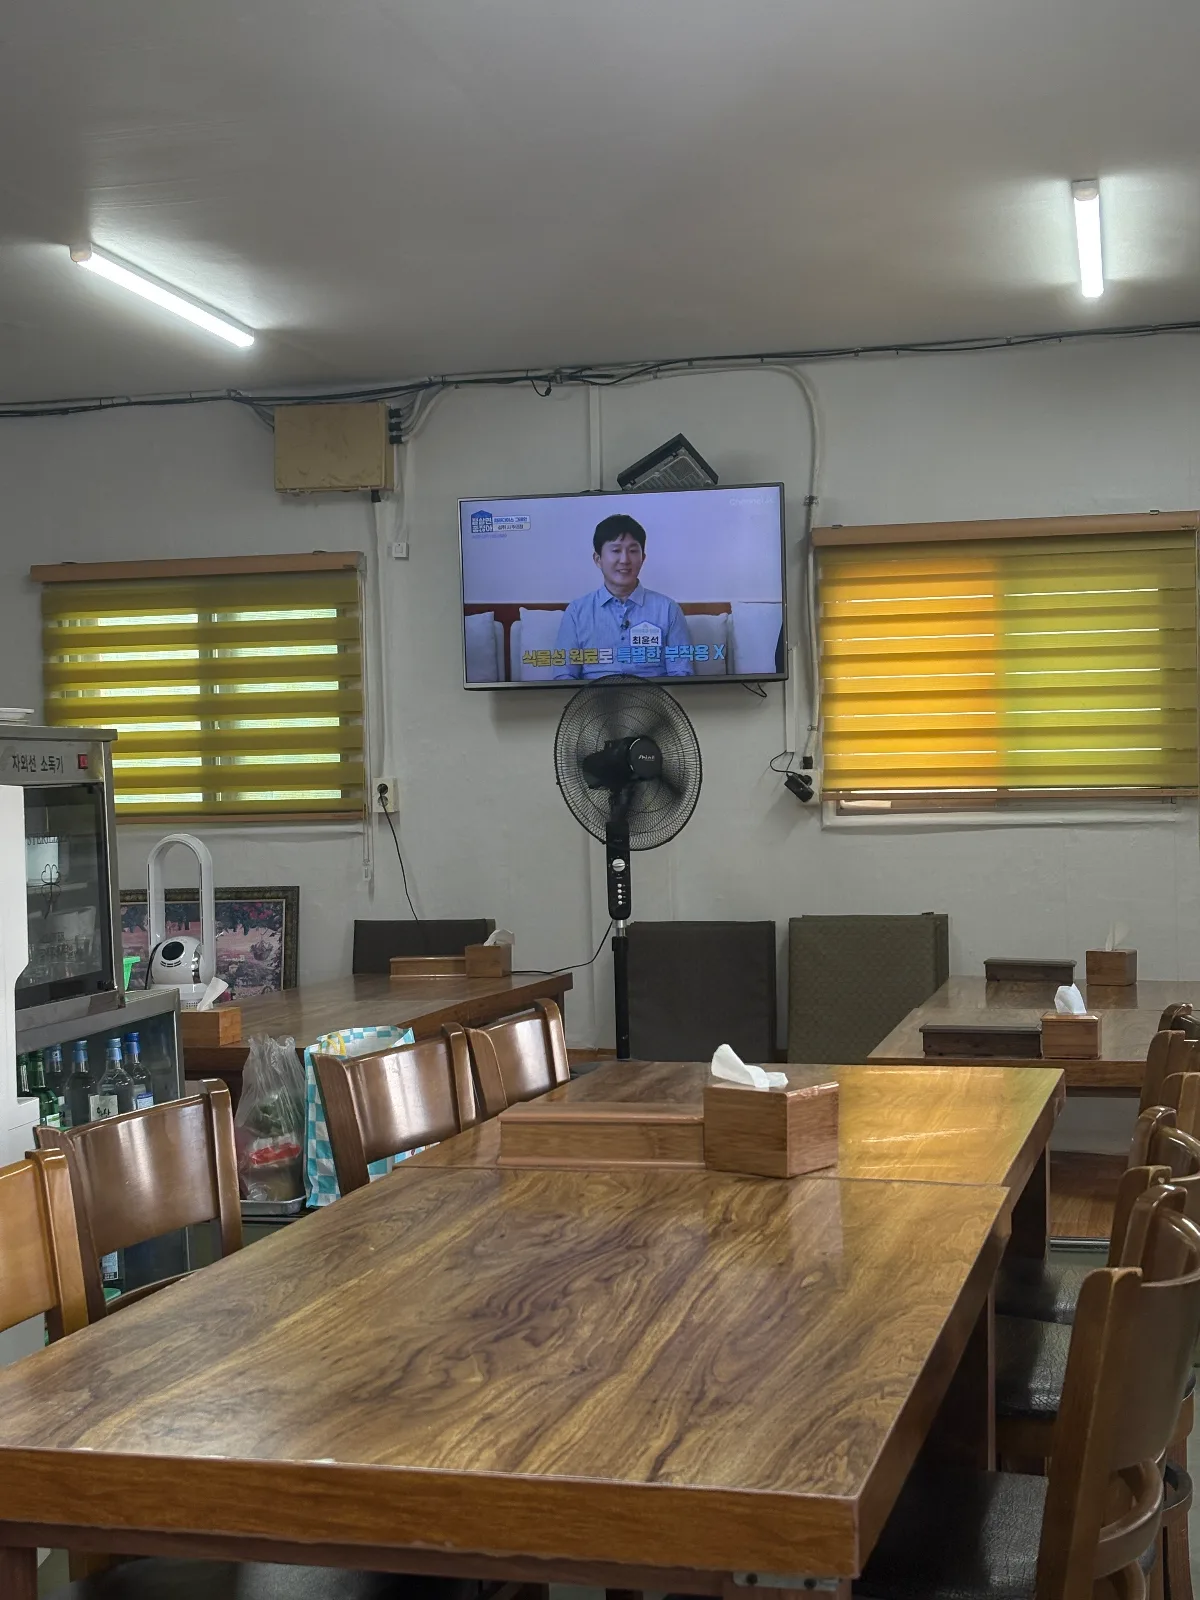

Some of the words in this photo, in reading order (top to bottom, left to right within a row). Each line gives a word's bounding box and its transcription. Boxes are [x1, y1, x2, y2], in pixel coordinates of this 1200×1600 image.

[632, 635, 660, 646] 최윤석
[522, 649, 567, 667] 식물성
[569, 648, 614, 665] 원료로
[616, 646, 662, 664] 특별한
[665, 644, 709, 662] 부작용
[713, 643, 725, 660] X
[12, 754, 37, 773] 자외선
[40, 755, 64, 774] 소독기
